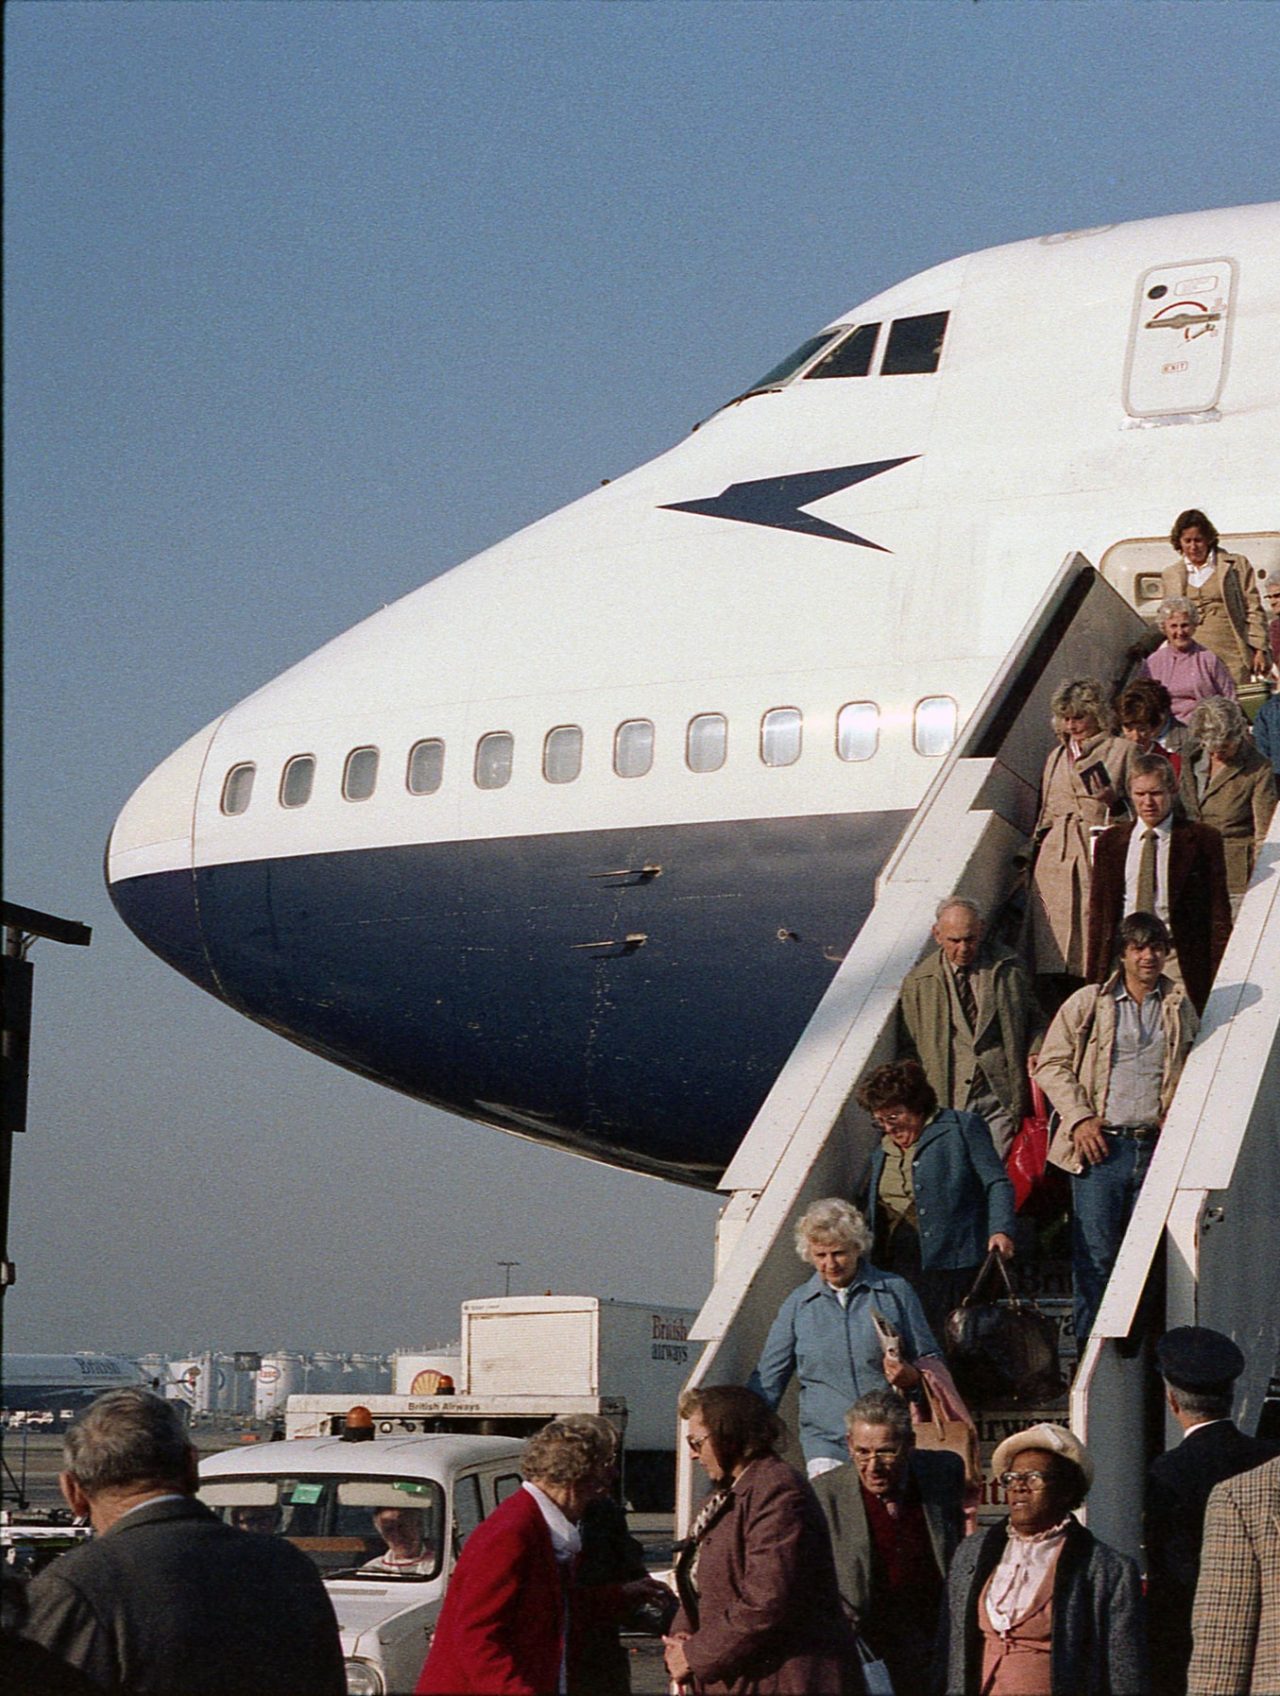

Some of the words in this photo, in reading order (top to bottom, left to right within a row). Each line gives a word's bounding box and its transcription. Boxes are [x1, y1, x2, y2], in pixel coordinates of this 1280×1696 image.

[652, 1315, 688, 1341] British
[652, 1344, 688, 1365] airways
[408, 1402, 440, 1411] British
[442, 1402, 480, 1412] Airways
